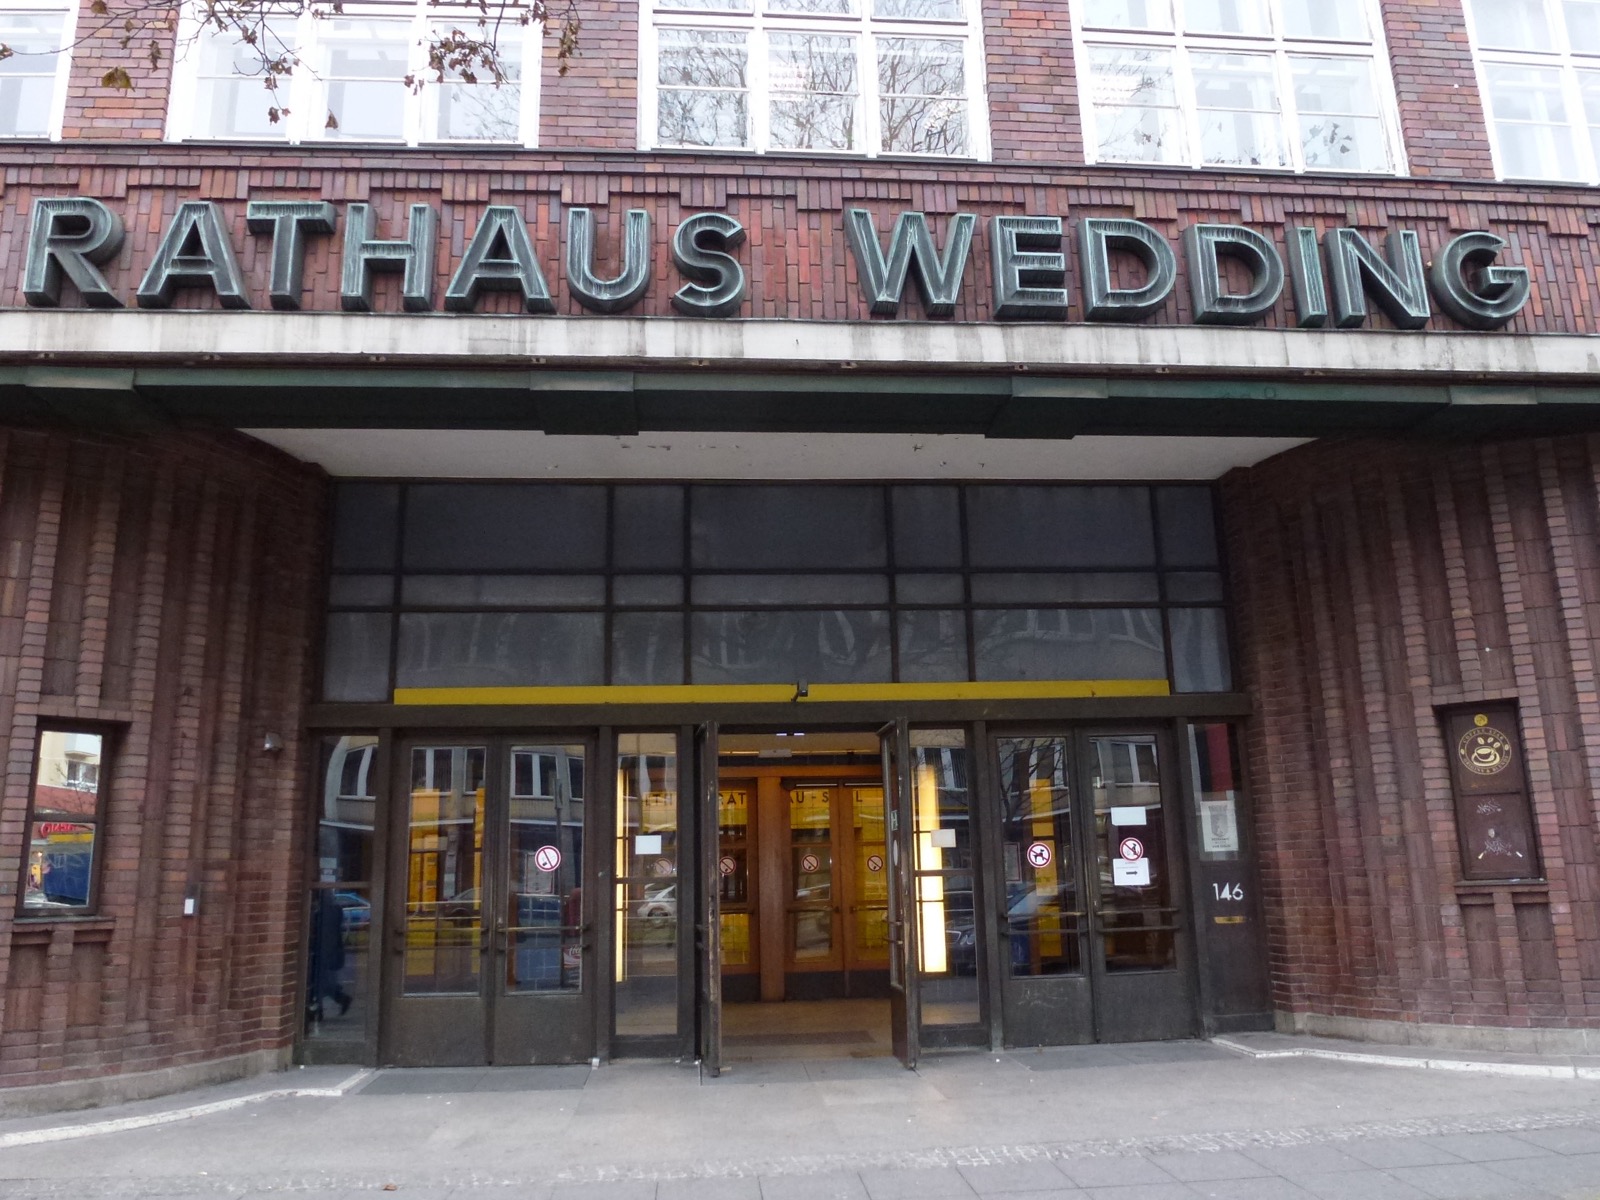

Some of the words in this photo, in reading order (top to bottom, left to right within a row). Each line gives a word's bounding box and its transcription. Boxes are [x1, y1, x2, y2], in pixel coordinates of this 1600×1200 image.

[23, 197, 746, 315] RATHAUS
[846, 208, 1531, 330] WEDDING
[1212, 882, 1244, 901] 146
